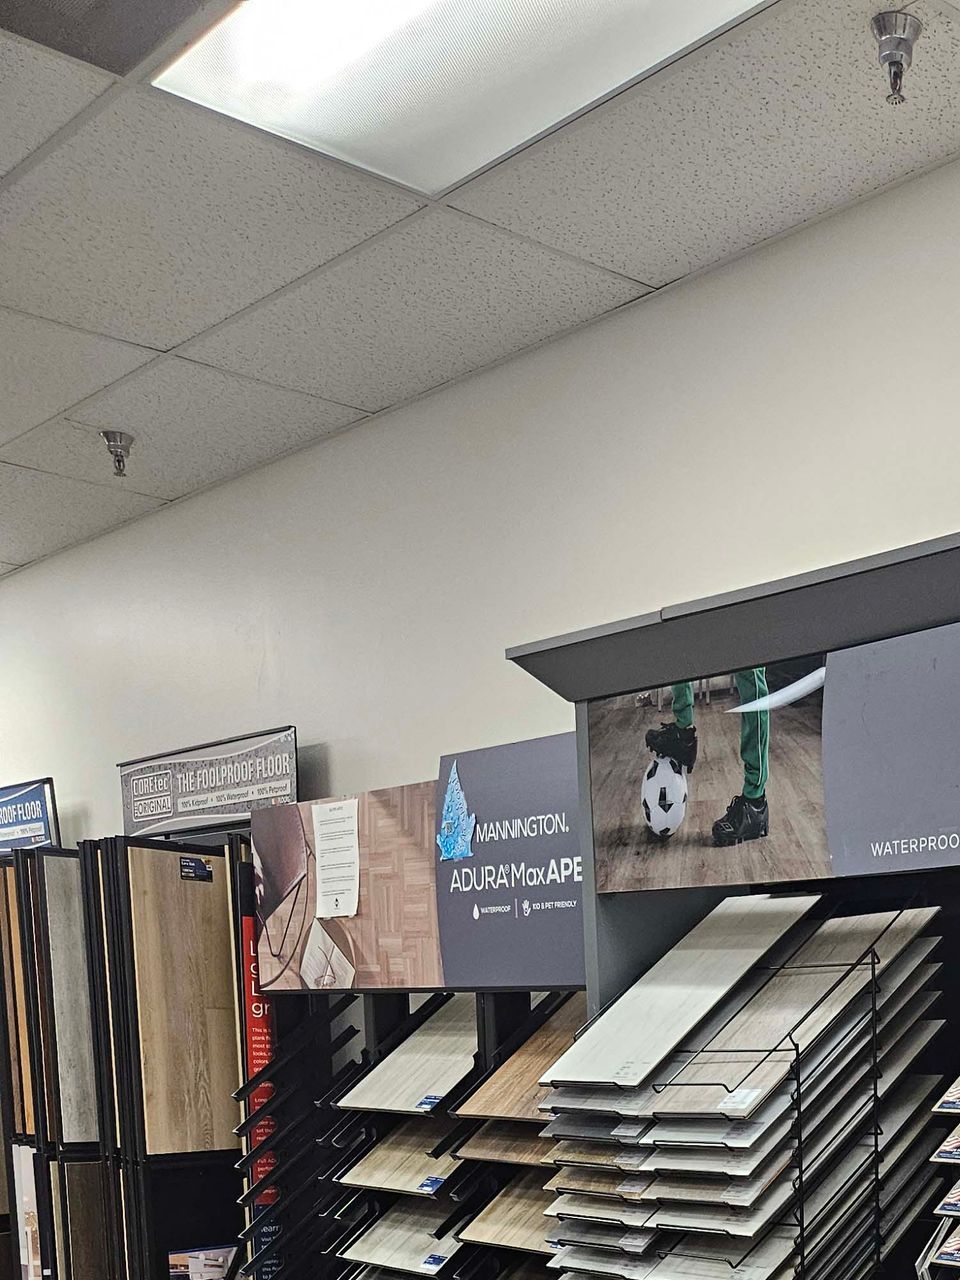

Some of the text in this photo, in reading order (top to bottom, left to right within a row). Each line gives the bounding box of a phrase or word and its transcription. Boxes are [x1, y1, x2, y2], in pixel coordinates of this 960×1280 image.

[176, 753, 290, 794] THE FOOLPROOF FLOOR
[17, 800, 43, 820] FLOOR
[138, 796, 171, 815] ORIGINAL
[480, 905, 511, 914] WATERPROOF
[554, 900, 577, 909] FRIENDLY
